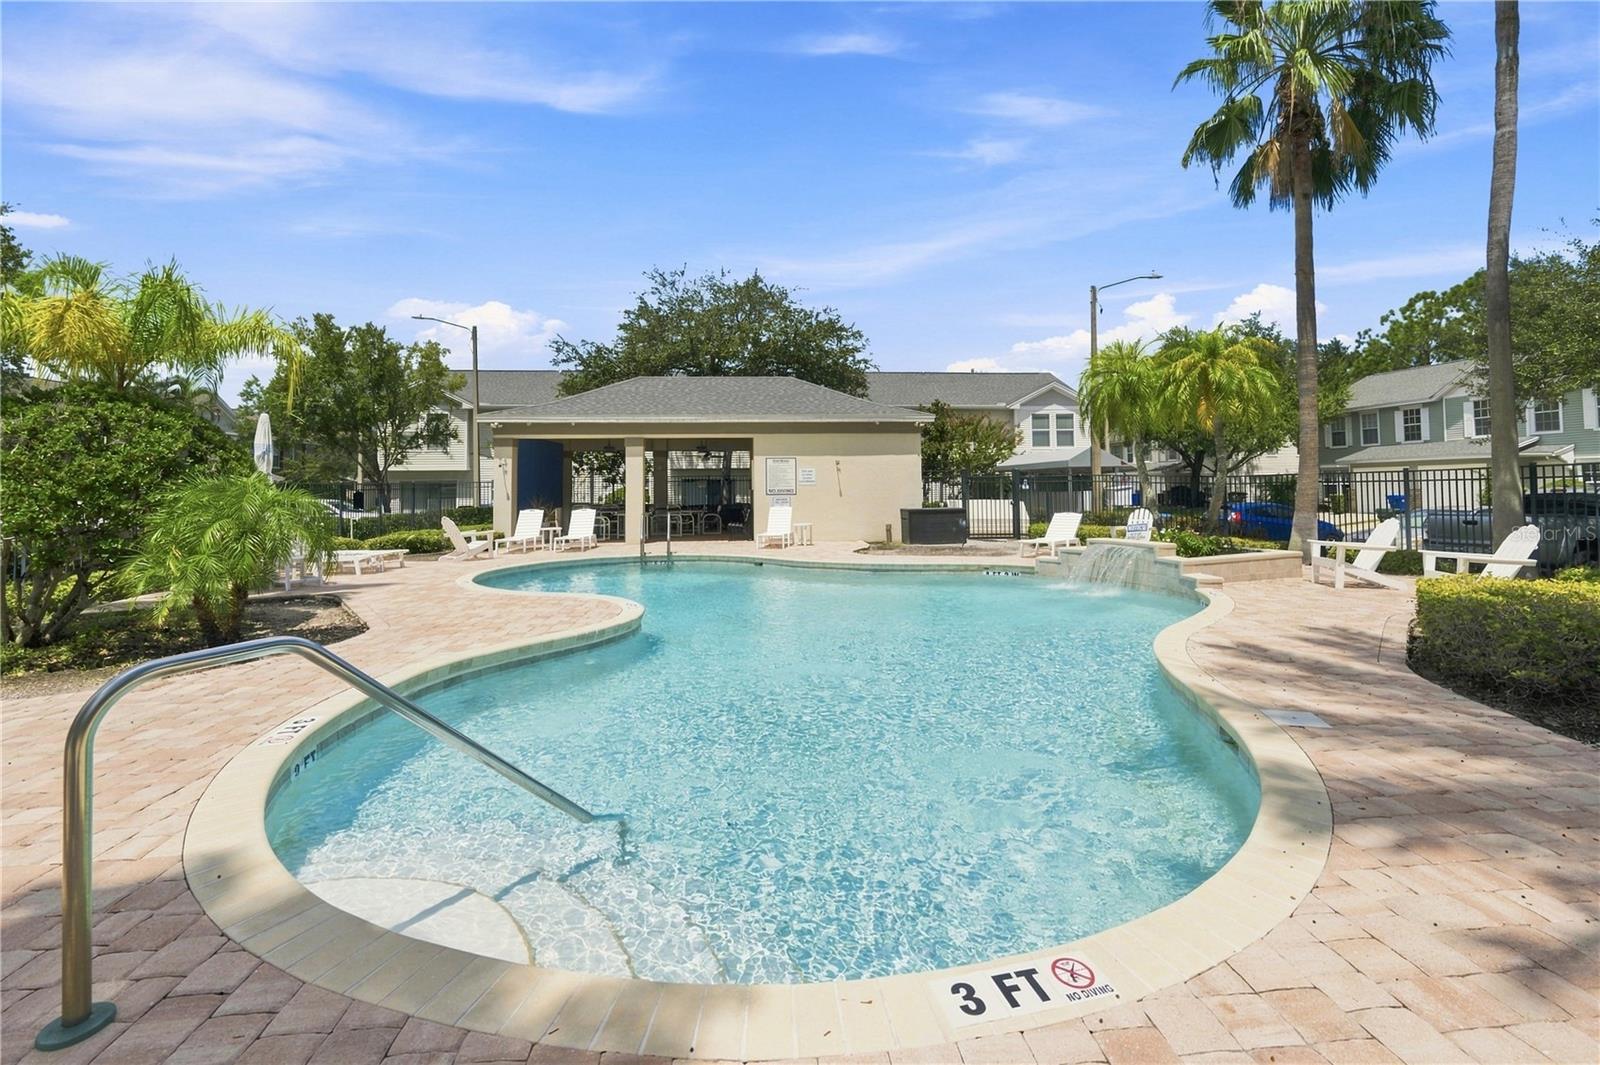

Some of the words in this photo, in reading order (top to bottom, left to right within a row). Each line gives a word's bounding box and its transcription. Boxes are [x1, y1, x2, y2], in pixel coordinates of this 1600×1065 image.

[303, 749, 316, 769] FT
[950, 982, 987, 1016] 3
[991, 967, 1051, 1009] FT
[1065, 991, 1082, 1002] NO
[1080, 984, 1115, 999] DIVING
